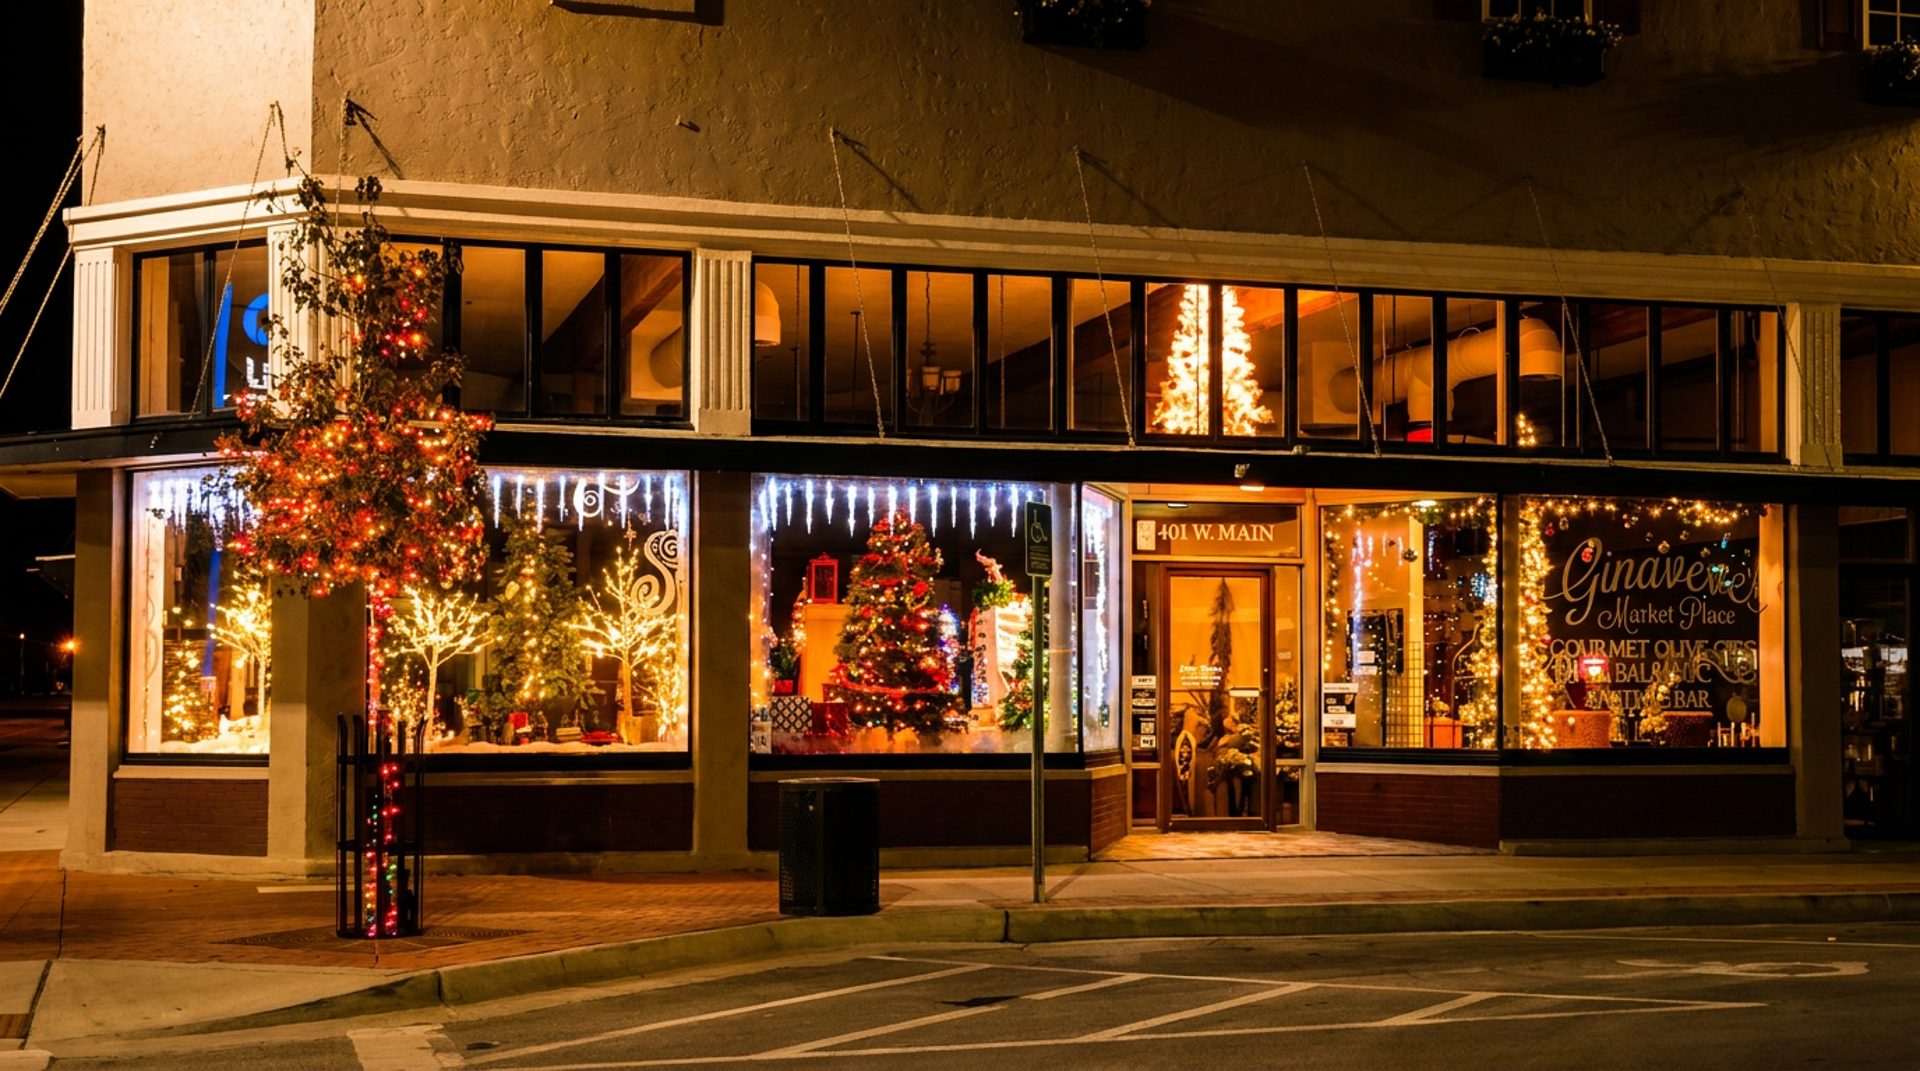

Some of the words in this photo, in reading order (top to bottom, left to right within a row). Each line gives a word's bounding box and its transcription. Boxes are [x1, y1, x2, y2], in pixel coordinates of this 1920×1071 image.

[1157, 523, 1188, 541] 401
[1192, 523, 1215, 541] W.
[1217, 523, 1275, 542] MAIN
[1597, 595, 1675, 635] Market
[1679, 596, 1736, 630] Place
[1674, 690, 1713, 709] BAR
